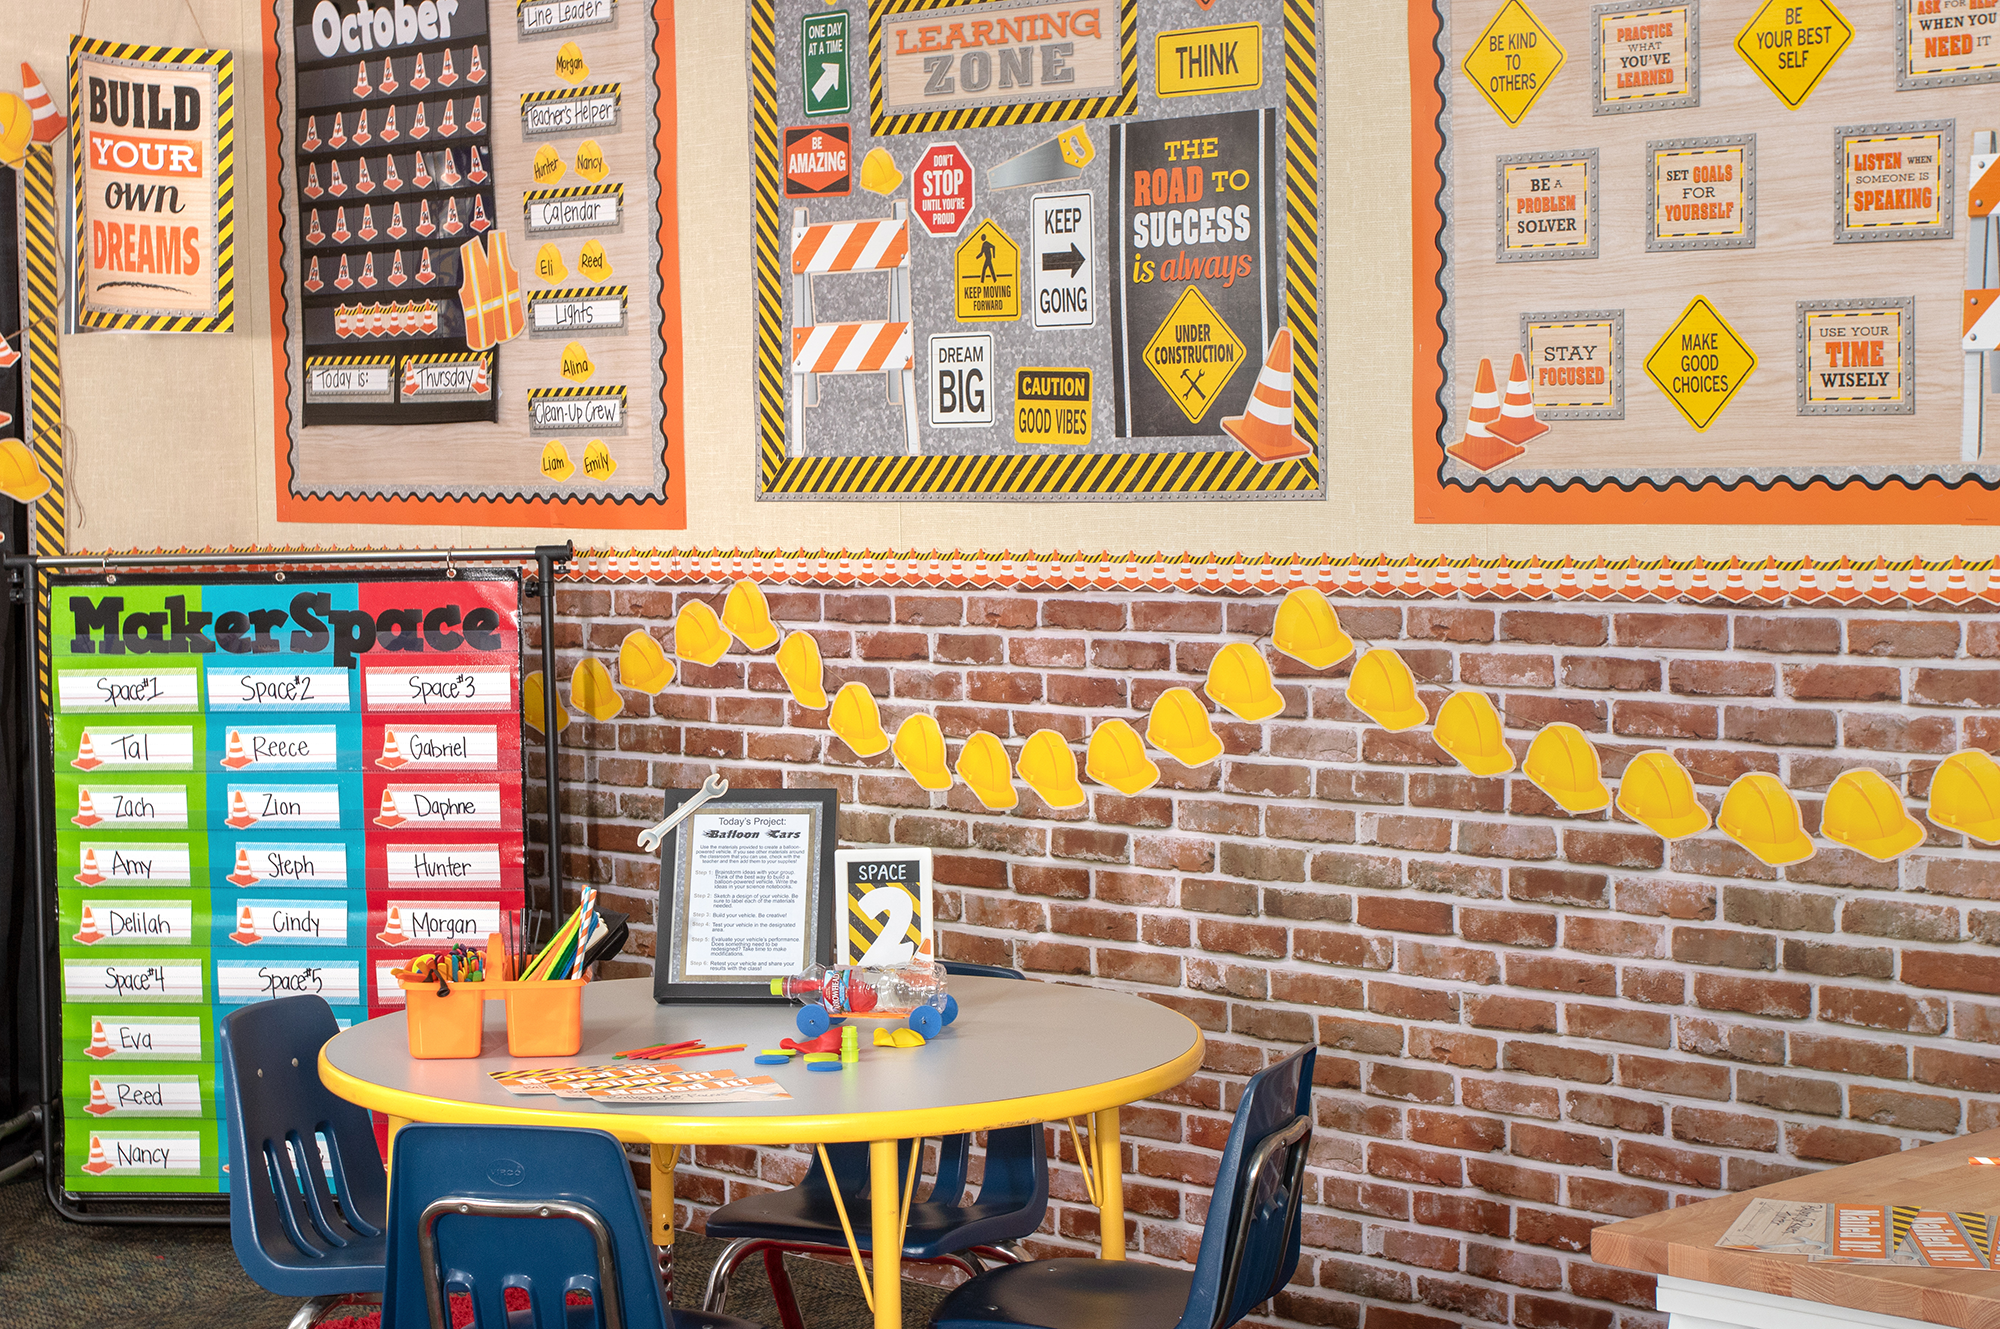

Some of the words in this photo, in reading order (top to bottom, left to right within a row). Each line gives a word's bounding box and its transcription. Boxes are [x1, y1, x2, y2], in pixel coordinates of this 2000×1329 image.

[527, 8, 553, 28] Line
[558, 0, 602, 23] Leader
[1785, 7, 1802, 26] BE
[1917, 0, 1941, 15] ASK
[1944, 0, 1966, 8] FOR
[312, 0, 459, 57] October
[808, 24, 826, 40] ONE
[827, 22, 843, 37] DAY
[896, 8, 1101, 56] LEARNING
[1617, 22, 1673, 42] PRACTICE
[1919, 16, 1965, 31] WHEN
[1967, 12, 1998, 26] YOU
[808, 43, 818, 56] AT
[818, 42, 824, 54] A
[826, 39, 843, 54] TIME
[1490, 35, 1504, 52] BE
[1508, 32, 1537, 50] KIND
[1628, 41, 1662, 52] WHAT
[1756, 29, 1793, 50] YOUR
[1797, 26, 1832, 46] BEST
[1924, 34, 1973, 58] NEED
[1976, 36, 1992, 46] IT
[556, 56, 584, 75] Morgan
[923, 42, 1075, 96] ZONE
[1176, 41, 1239, 80] THINK
[1505, 54, 1521, 70] TO
[1620, 52, 1671, 68] YOU'VE
[1778, 50, 1809, 70] SELF
[1490, 73, 1537, 92] OTHERS
[1617, 68, 1674, 88] LEARNED
[89, 76, 201, 131] BUILD
[525, 104, 572, 128] Teacher's
[575, 100, 612, 124] Helper
[811, 136, 822, 150] BE
[1164, 137, 1218, 162] THE
[92, 138, 198, 172] YOUR
[577, 154, 603, 173] Nancy
[788, 151, 846, 174] AMAZING
[934, 154, 953, 167] DON'T
[1854, 152, 1902, 172] LISTEN
[1907, 155, 1932, 165] WHEN
[533, 157, 558, 179] Hunter
[1666, 170, 1690, 182] SET
[1693, 164, 1734, 184] GOALS
[1856, 173, 1916, 184] SOMEONE
[1918, 172, 1930, 182] IS
[922, 169, 964, 197] STOP
[1134, 165, 1204, 207] ROAD
[1212, 169, 1250, 192] TO
[1530, 178, 1550, 192] BE
[1554, 179, 1563, 188] A
[1682, 186, 1716, 200] FOR
[105, 181, 186, 214] own
[922, 198, 940, 211] UNTIL
[941, 197, 965, 210] YOU'RE
[1516, 195, 1576, 214] PROBLEM
[1854, 186, 1932, 212] SPEAKING
[543, 202, 601, 225] Calendar
[932, 212, 955, 226] PROUD
[1044, 208, 1082, 234] KEEP
[1665, 201, 1735, 222] YOURSELF
[1133, 205, 1251, 248] SUCCESS
[1518, 218, 1577, 234] SOLVER
[93, 220, 200, 276] DREAMS
[540, 259, 554, 276] Eli
[581, 252, 603, 269] Reed
[1132, 252, 1154, 283] is
[1160, 250, 1252, 288] always
[964, 286, 982, 299] KEEP
[983, 285, 1011, 298] MOVING
[1040, 287, 1088, 314] GOING
[555, 302, 594, 326] Lights
[973, 300, 1003, 312] FORWARD
[1175, 323, 1210, 344] UNDER
[1681, 332, 1718, 352] MAKE
[1819, 327, 1846, 338] USE
[1848, 325, 1889, 337] YOUR
[939, 346, 984, 364] DREAM
[1154, 344, 1234, 366] CONSTRUCTION
[1544, 345, 1598, 362] STAY
[1681, 354, 1720, 373] GOOD
[1825, 340, 1884, 368] TIME
[562, 359, 589, 376] Alina
[1539, 366, 1605, 388] FOCUSED
[316, 370, 352, 389] Today
[357, 370, 369, 388] is:
[417, 367, 474, 392] Thursday
[1022, 376, 1085, 396] CAUTION
[1672, 375, 1729, 395] CHOICES
[1820, 372, 1890, 389] WISELY
[939, 368, 985, 414] BIG
[534, 401, 582, 425] Clean-Up
[585, 400, 617, 423] Crew
[1018, 408, 1050, 434] GOOD
[1056, 408, 1087, 435] VIBES
[542, 457, 565, 472] Liam
[584, 453, 610, 474] Emily
[111, 734, 149, 761] Tal
[252, 736, 310, 758] Reece
[410, 734, 467, 759] Gabriel
[114, 796, 155, 818] Zach
[262, 794, 301, 819] Zion
[414, 793, 476, 819] Daphne
[718, 817, 752, 828] Today's
[754, 817, 787, 828] Project:
[702, 829, 760, 838] Balloon
[766, 829, 801, 838] Cars
[111, 850, 153, 878] Amy
[267, 852, 315, 879] Steph
[414, 854, 472, 878] Hunter
[858, 864, 907, 880] SPACE
[110, 908, 170, 936] Delilah
[272, 910, 320, 938] Cindy
[412, 912, 477, 940] Morgan
[858, 886, 914, 966] 2
[120, 1026, 152, 1050] Eva
[676, 1072, 715, 1080] It!
[117, 1084, 163, 1107] Reed
[604, 1083, 709, 1096] Nailed
[714, 1078, 754, 1088] It!
[117, 1142, 170, 1169] Nancy
[1839, 1209, 1881, 1238] Nailed
[1910, 1216, 1965, 1248] Nailed
